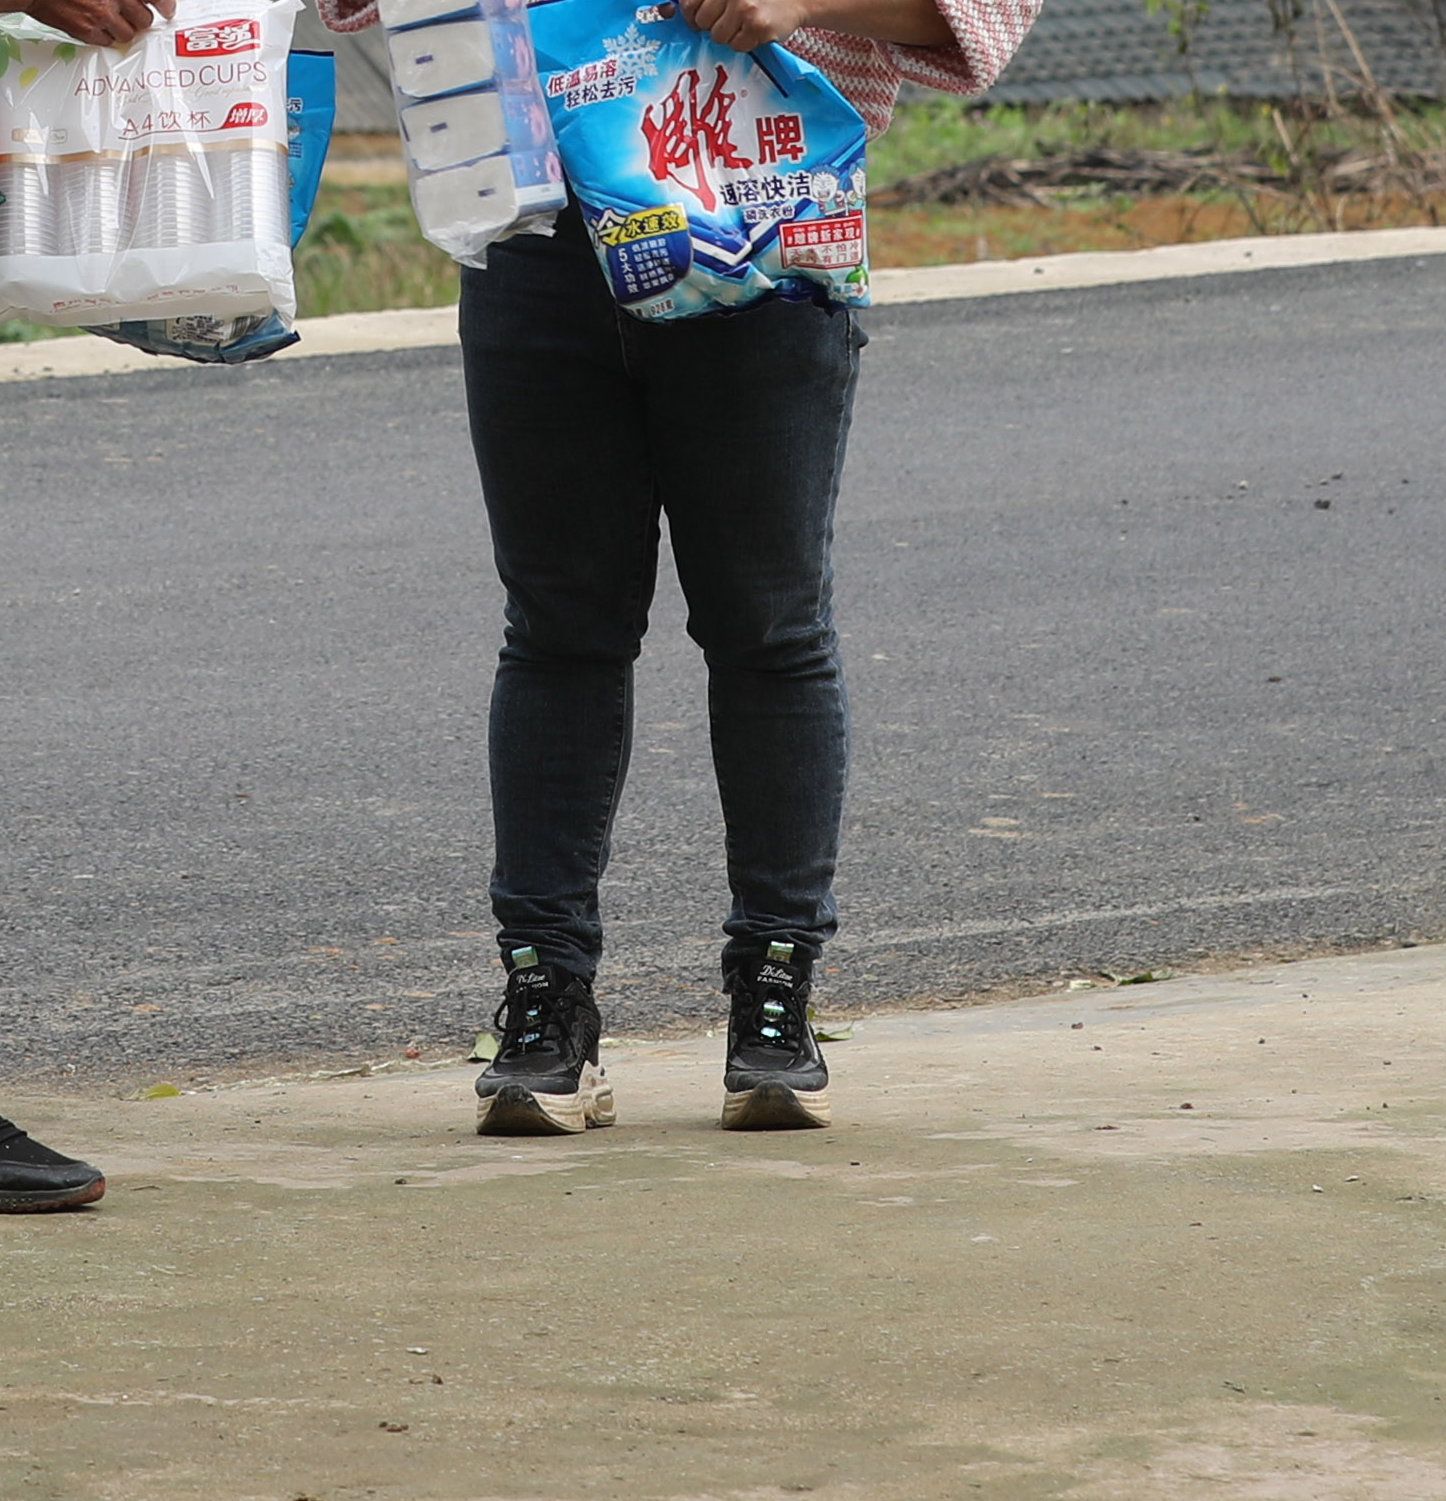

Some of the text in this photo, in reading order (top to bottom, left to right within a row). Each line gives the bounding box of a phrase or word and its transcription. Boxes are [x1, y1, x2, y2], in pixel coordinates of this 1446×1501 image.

[548, 59, 617, 95] 低温易溶
[565, 76, 635, 108] 轻松去污
[641, 64, 804, 212] 雕牌
[720, 173, 811, 205] 速溶快洁
